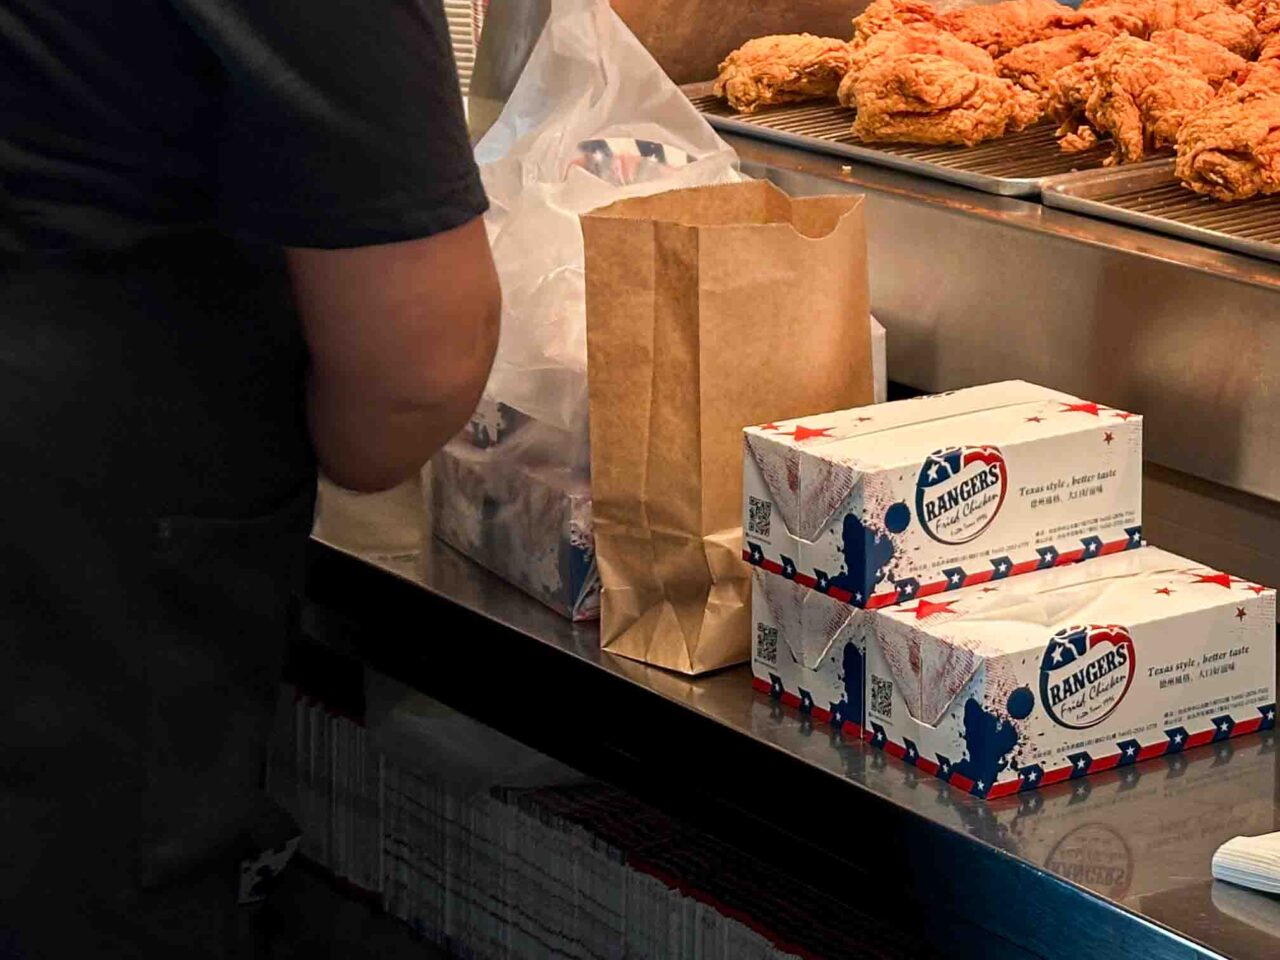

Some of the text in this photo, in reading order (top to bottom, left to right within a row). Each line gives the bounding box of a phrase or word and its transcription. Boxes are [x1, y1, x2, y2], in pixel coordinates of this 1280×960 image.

[925, 464, 999, 522] RANGERS
[1019, 486, 1044, 497] Texas
[1071, 474, 1095, 487] better
[1097, 469, 1117, 480] taste
[936, 492, 999, 534] Fried Chicken
[1050, 644, 1127, 707] RANGERS
[1148, 667, 1174, 678] Texas
[1202, 651, 1227, 664] better
[1229, 645, 1250, 657] taste
[1061, 675, 1127, 719] Fried Chicken
